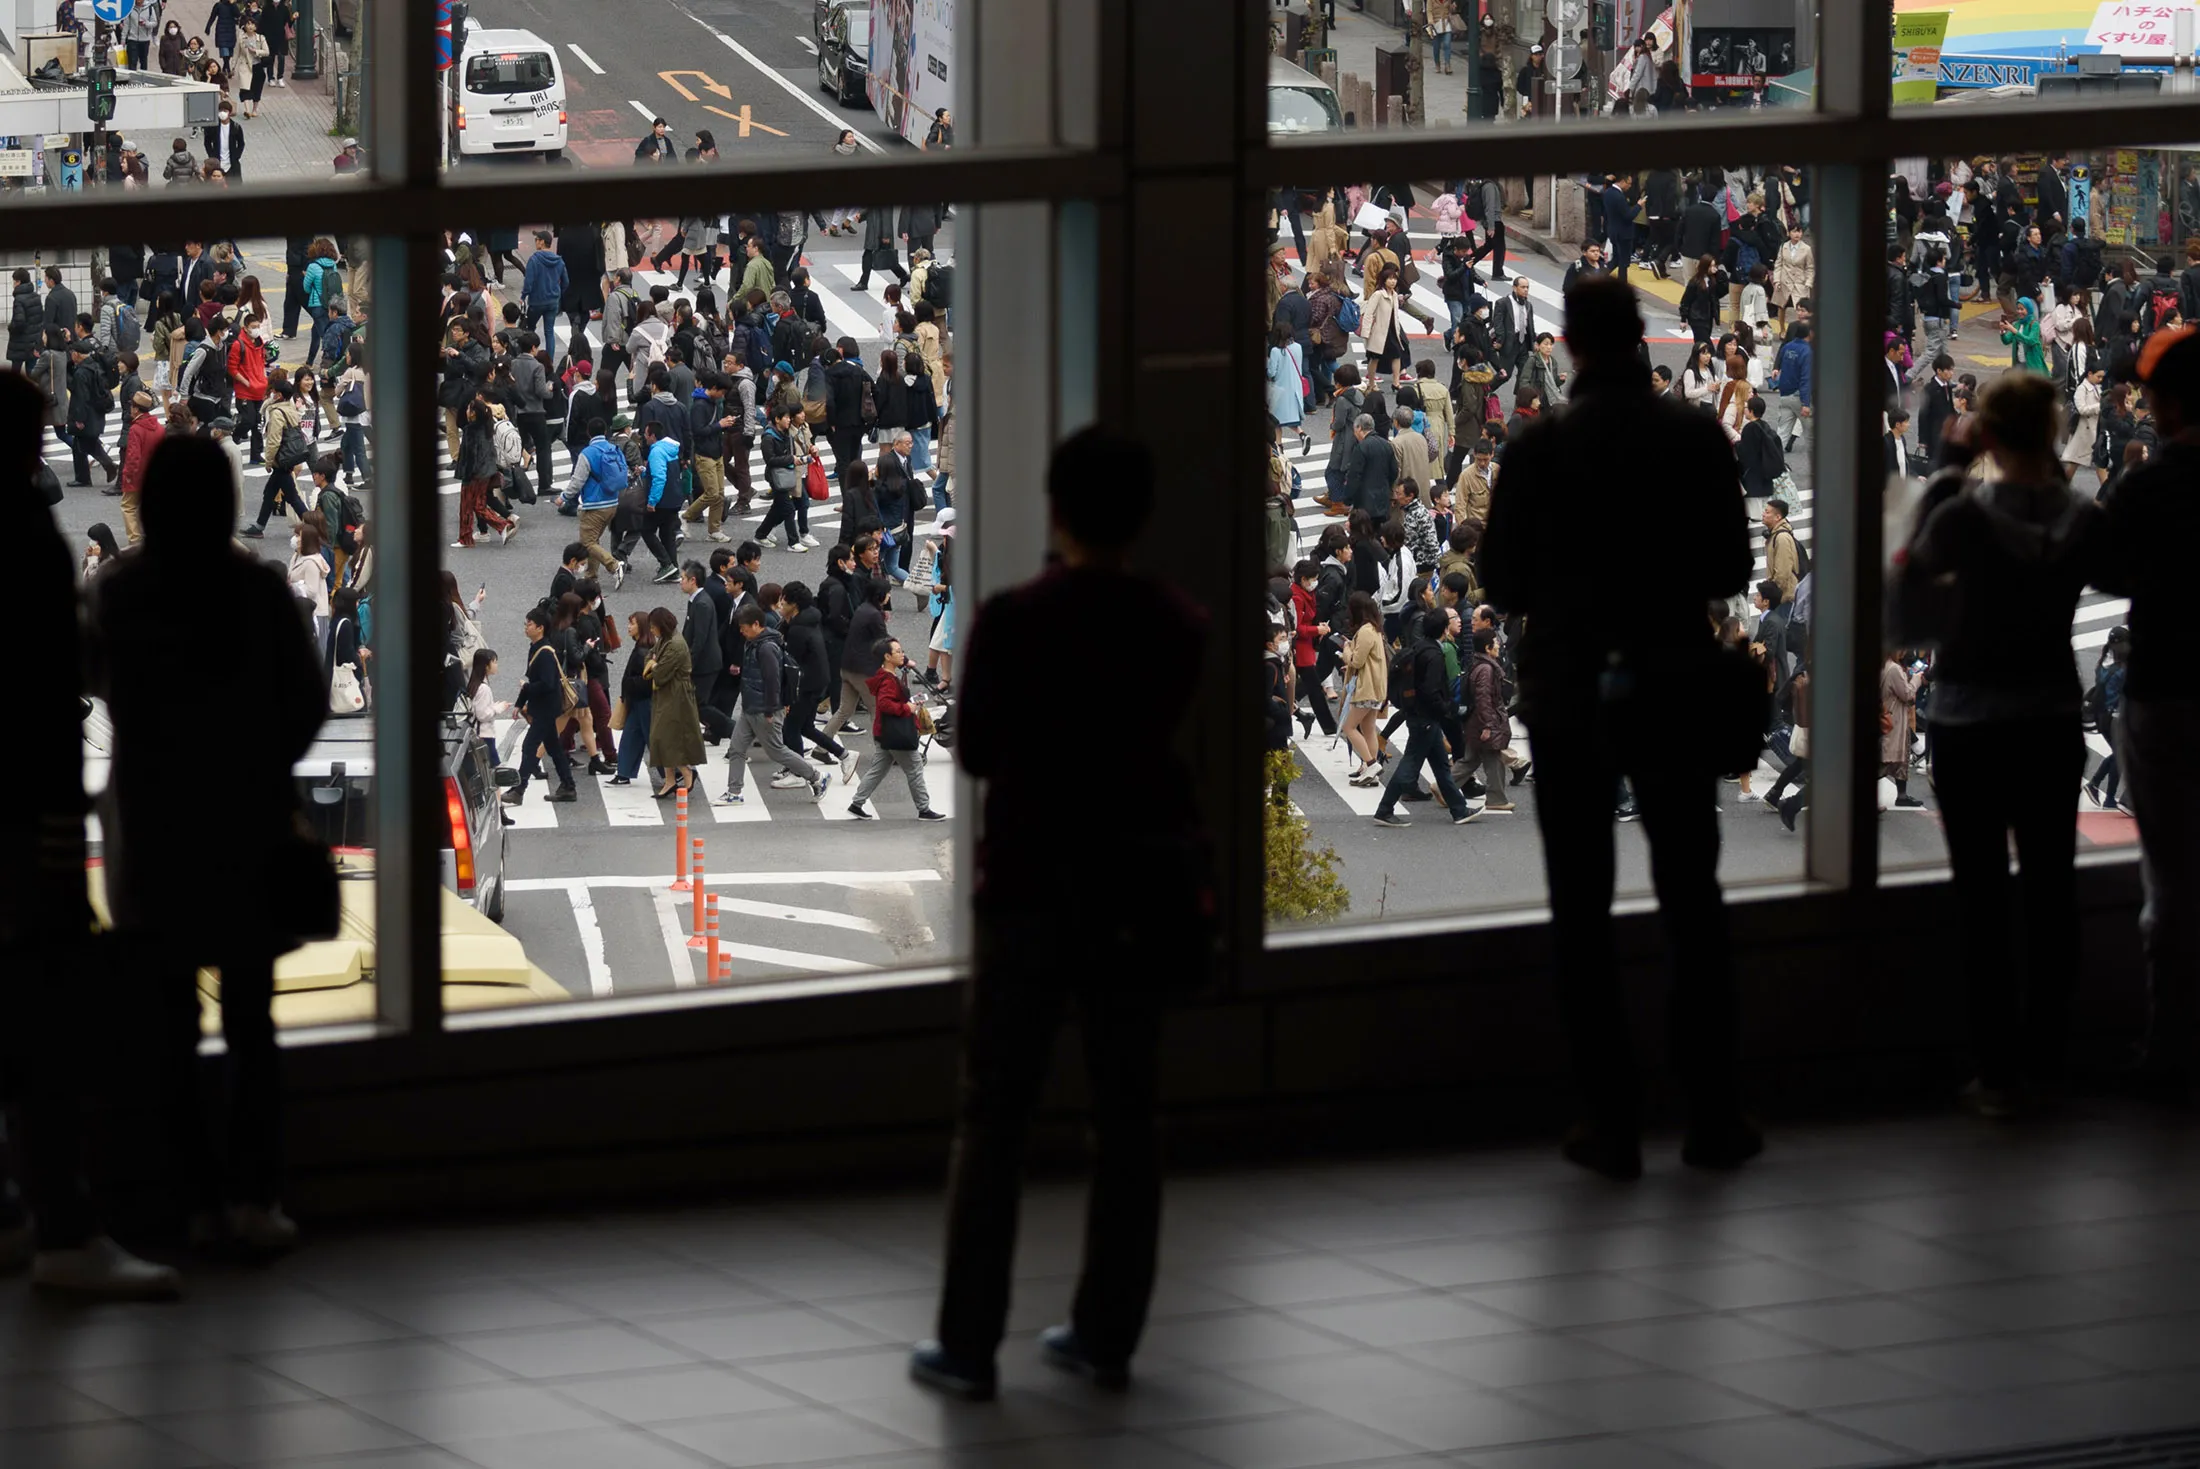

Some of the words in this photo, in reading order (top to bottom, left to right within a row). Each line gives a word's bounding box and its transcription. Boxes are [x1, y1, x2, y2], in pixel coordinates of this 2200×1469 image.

[2112, 6, 2194, 18] ハチ公
[2138, 20, 2156, 30] の
[1901, 27, 1938, 37] SHIBUYA
[2097, 32, 2175, 46] くすり屋
[1938, 62, 2031, 86] NZENRI
[536, 100, 560, 118] BROS
[68, 154, 76, 164] 6
[2077, 168, 2084, 178] 7
[300, 420, 314, 429] GIR
